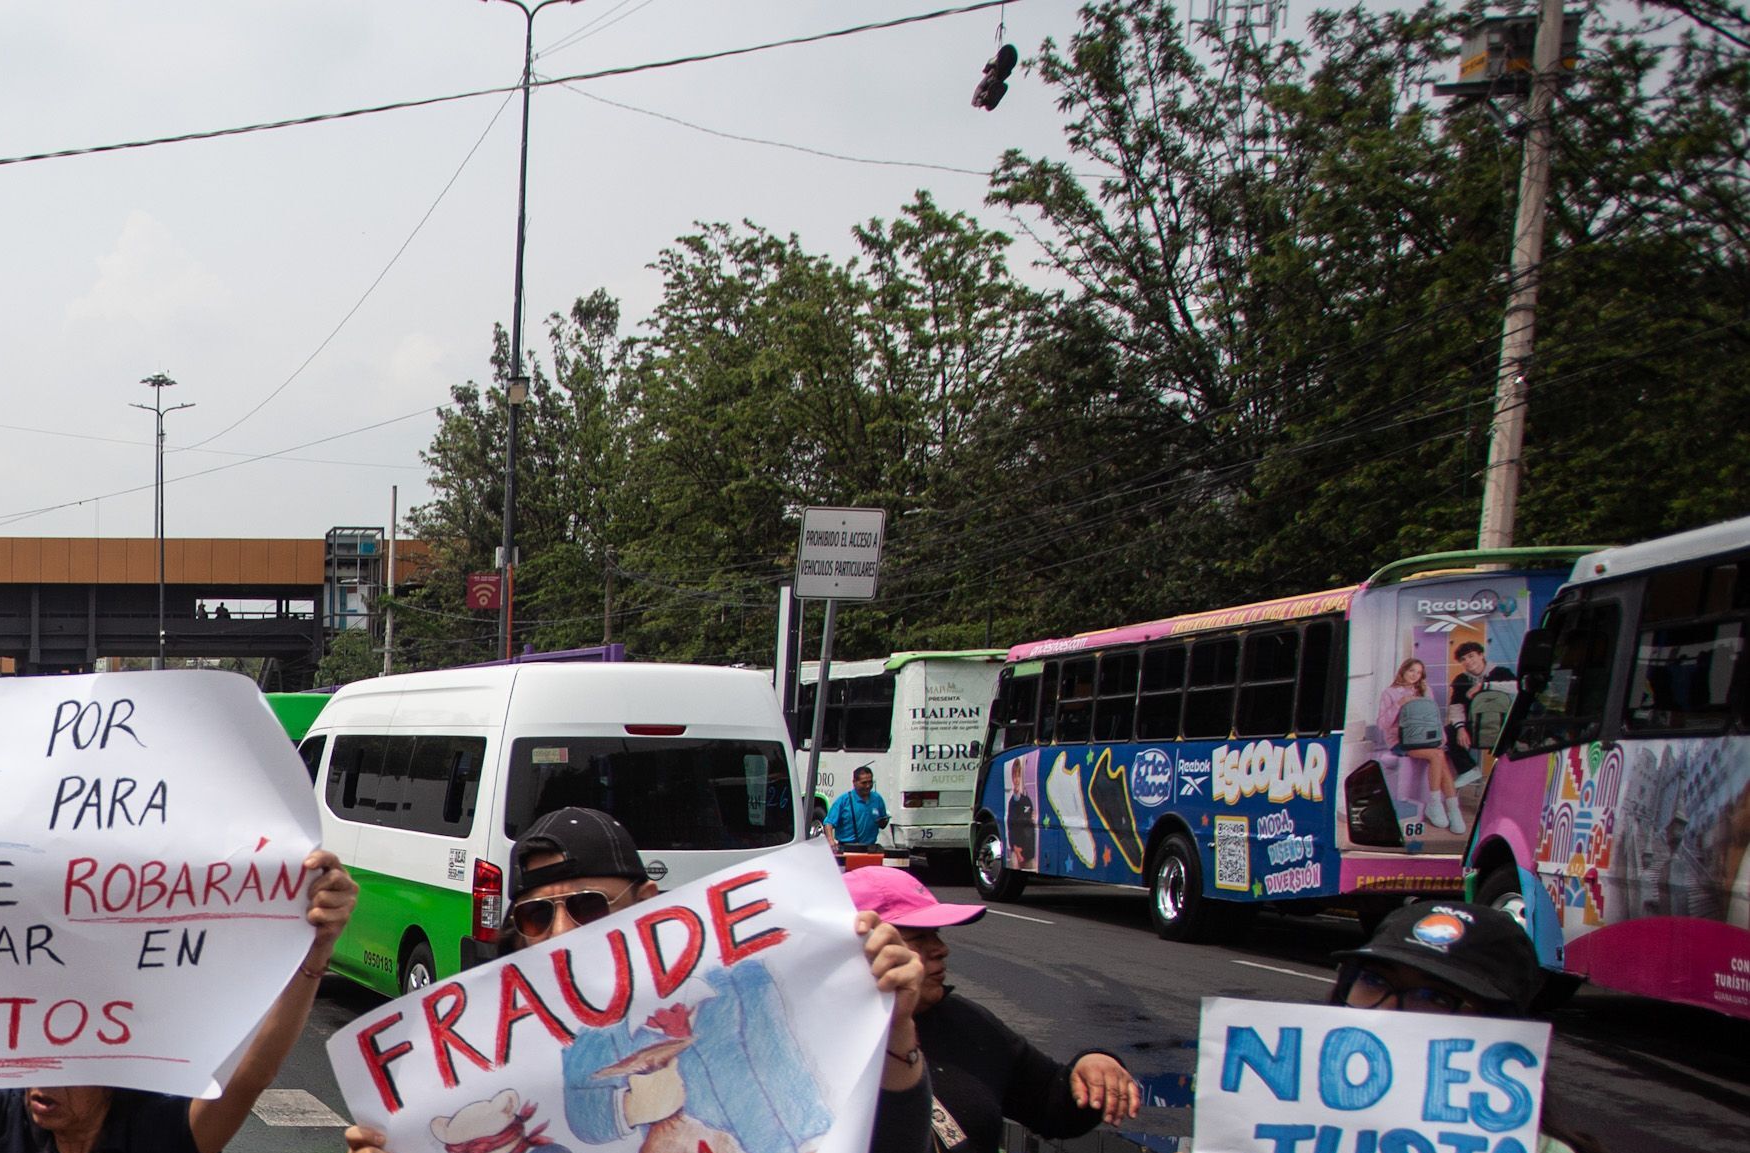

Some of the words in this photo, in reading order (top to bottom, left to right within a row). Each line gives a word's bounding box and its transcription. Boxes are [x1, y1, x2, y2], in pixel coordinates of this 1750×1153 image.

[805, 530, 840, 547] PROHIBIDO
[840, 531, 848, 547] EL
[848, 532, 872, 548] ACCESO
[872, 532, 878, 548] A
[834, 560, 877, 577] PARTICULARES
[1417, 598, 1495, 613] Reebok
[909, 706, 980, 719] TLALPAN
[47, 698, 147, 758] POR
[911, 744, 982, 760] PEDR
[911, 762, 951, 772] HACES
[1178, 758, 1211, 775] Reebok
[1212, 739, 1329, 805] ESCOLAR
[931, 775, 965, 784] AUTOR
[49, 775, 168, 832] PARA
[1256, 808, 1294, 840] MODA,
[1405, 822, 1423, 837] 68
[1268, 834, 1304, 866] DISEÑO
[65, 836, 308, 916] ROBARÁN
[1264, 860, 1321, 895] DIVERSIÓN
[1356, 873, 1465, 889] ENCUÉNTRALO
[137, 929, 207, 970] EN
[363, 950, 393, 974] 0950183
[356, 870, 791, 1115] FRAUDE
[1714, 973, 1750, 992] TURÍSTI
[1220, 1026, 1393, 1112] NO
[1422, 1038, 1538, 1133] ES
